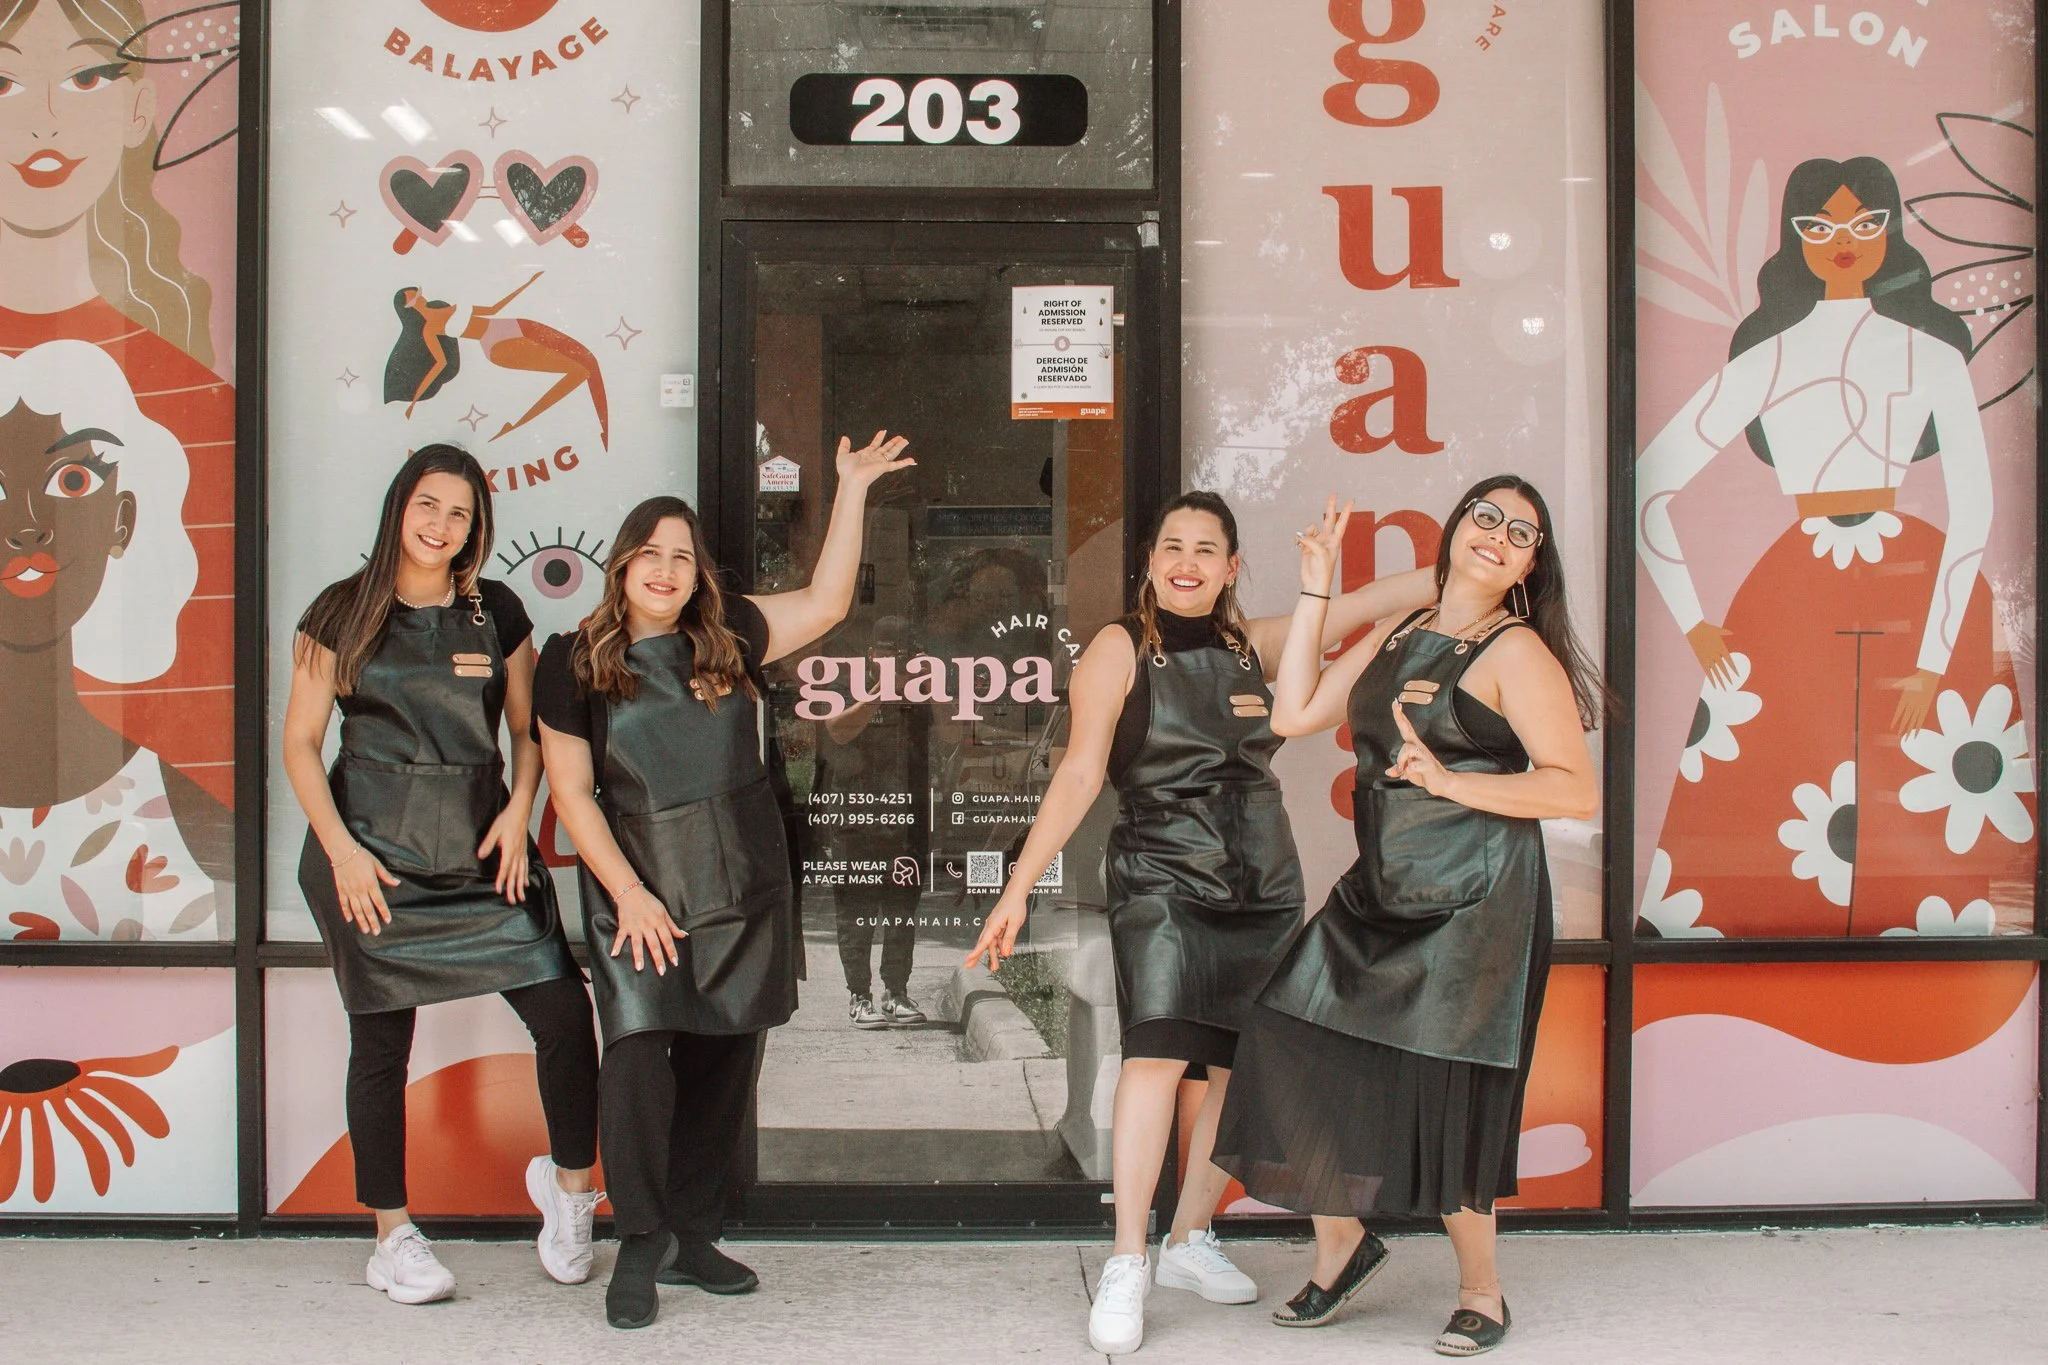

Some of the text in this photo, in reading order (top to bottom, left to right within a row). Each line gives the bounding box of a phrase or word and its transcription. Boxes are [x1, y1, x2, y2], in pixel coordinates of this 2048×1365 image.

[1475, 0, 1506, 51] ARE
[1728, 4, 1928, 68] SALON
[383, 16, 609, 82] BALAYAGE
[850, 78, 1021, 145] 203
[1043, 300, 1082, 308] RIGHT OF
[1038, 309, 1086, 317] ADMISSION
[1036, 357, 1088, 365] DERECHO DE
[1040, 365, 1084, 373] ADMISIÓN
[1080, 407, 1105, 416] guapa
[990, 613, 1049, 638] HAIR
[795, 655, 1059, 720] guapa
[808, 792, 913, 805] (407) 530-4251
[972, 795, 1041, 803] GUAPA.HAIR
[808, 813, 915, 826] (407) 995-6266
[802, 861, 887, 871] PLEASE WEAR
[802, 874, 883, 884] A FACE MASK
[856, 917, 982, 927] GUAPAHAIR.C
